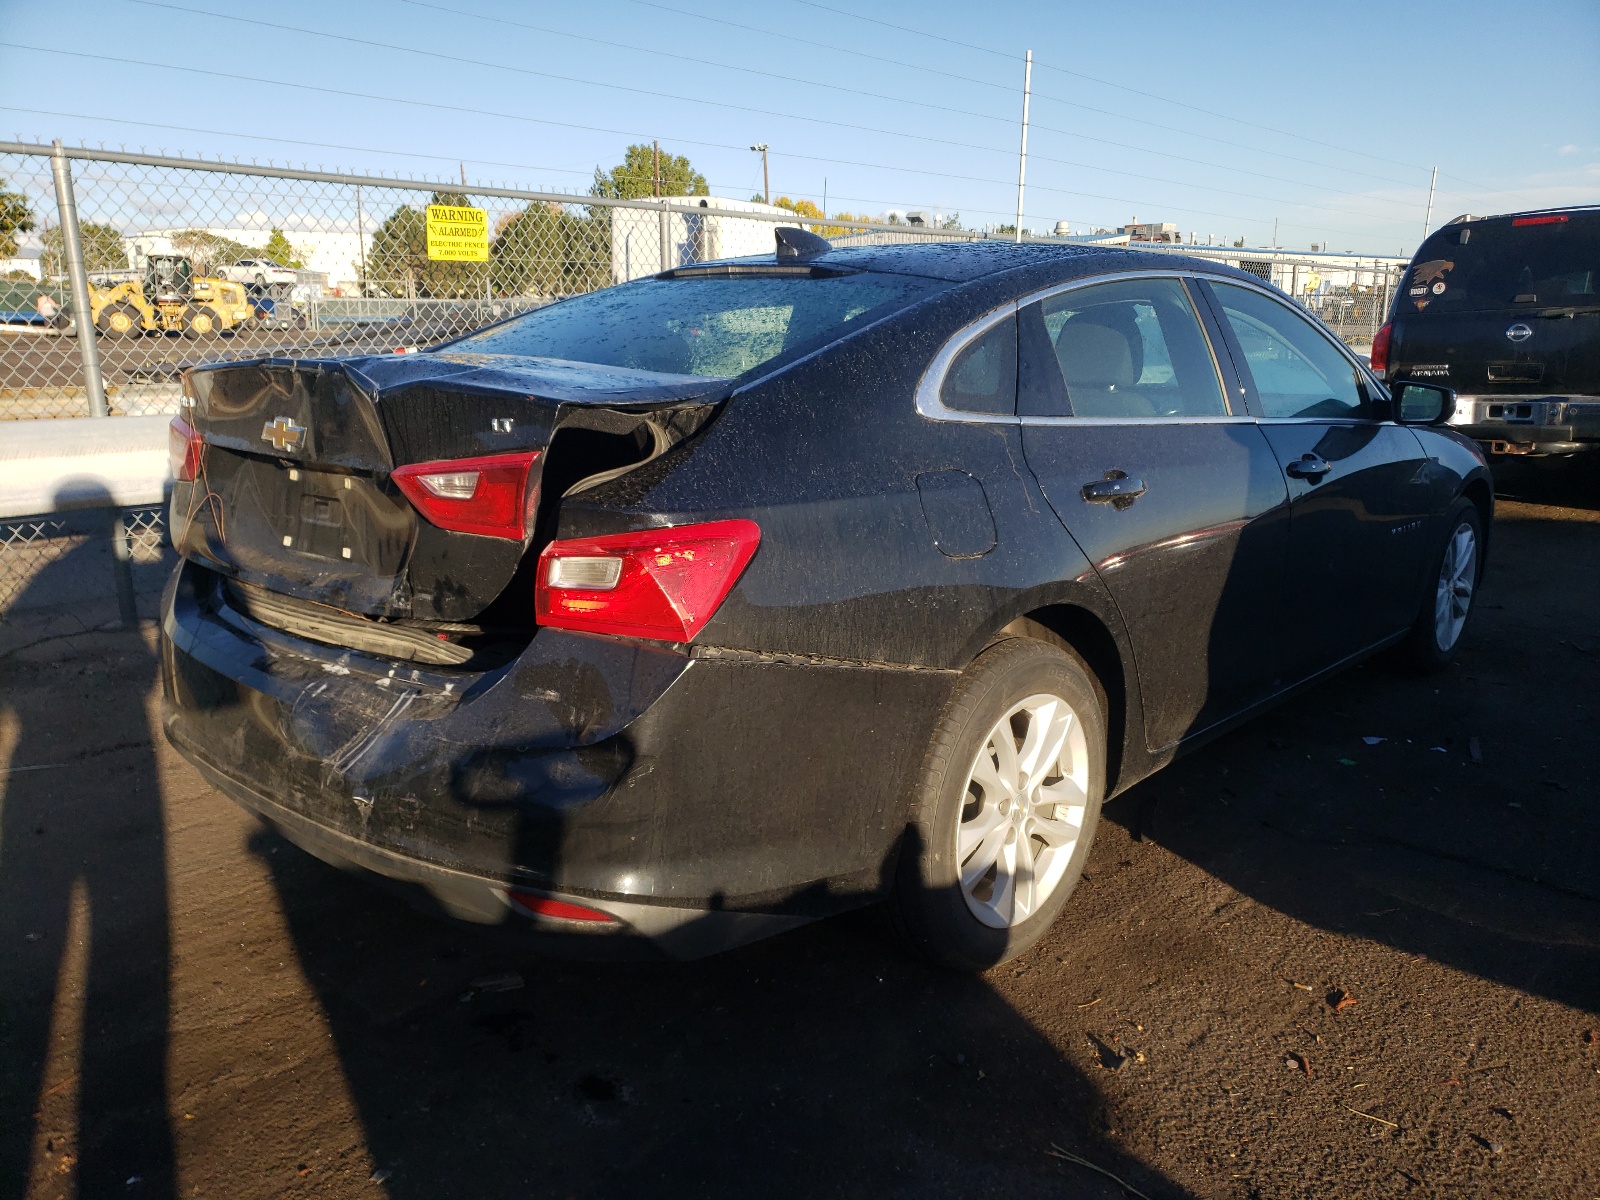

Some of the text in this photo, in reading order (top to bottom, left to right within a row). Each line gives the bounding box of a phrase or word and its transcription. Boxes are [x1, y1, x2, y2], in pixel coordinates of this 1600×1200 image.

[431, 209, 483, 222] WARNING
[439, 226, 478, 237] ALARMED
[430, 240, 462, 248] ELECTRIC
[438, 249, 457, 257] 7,000
[1410, 369, 1450, 377] ARMADA
[491, 418, 514, 434] LT
